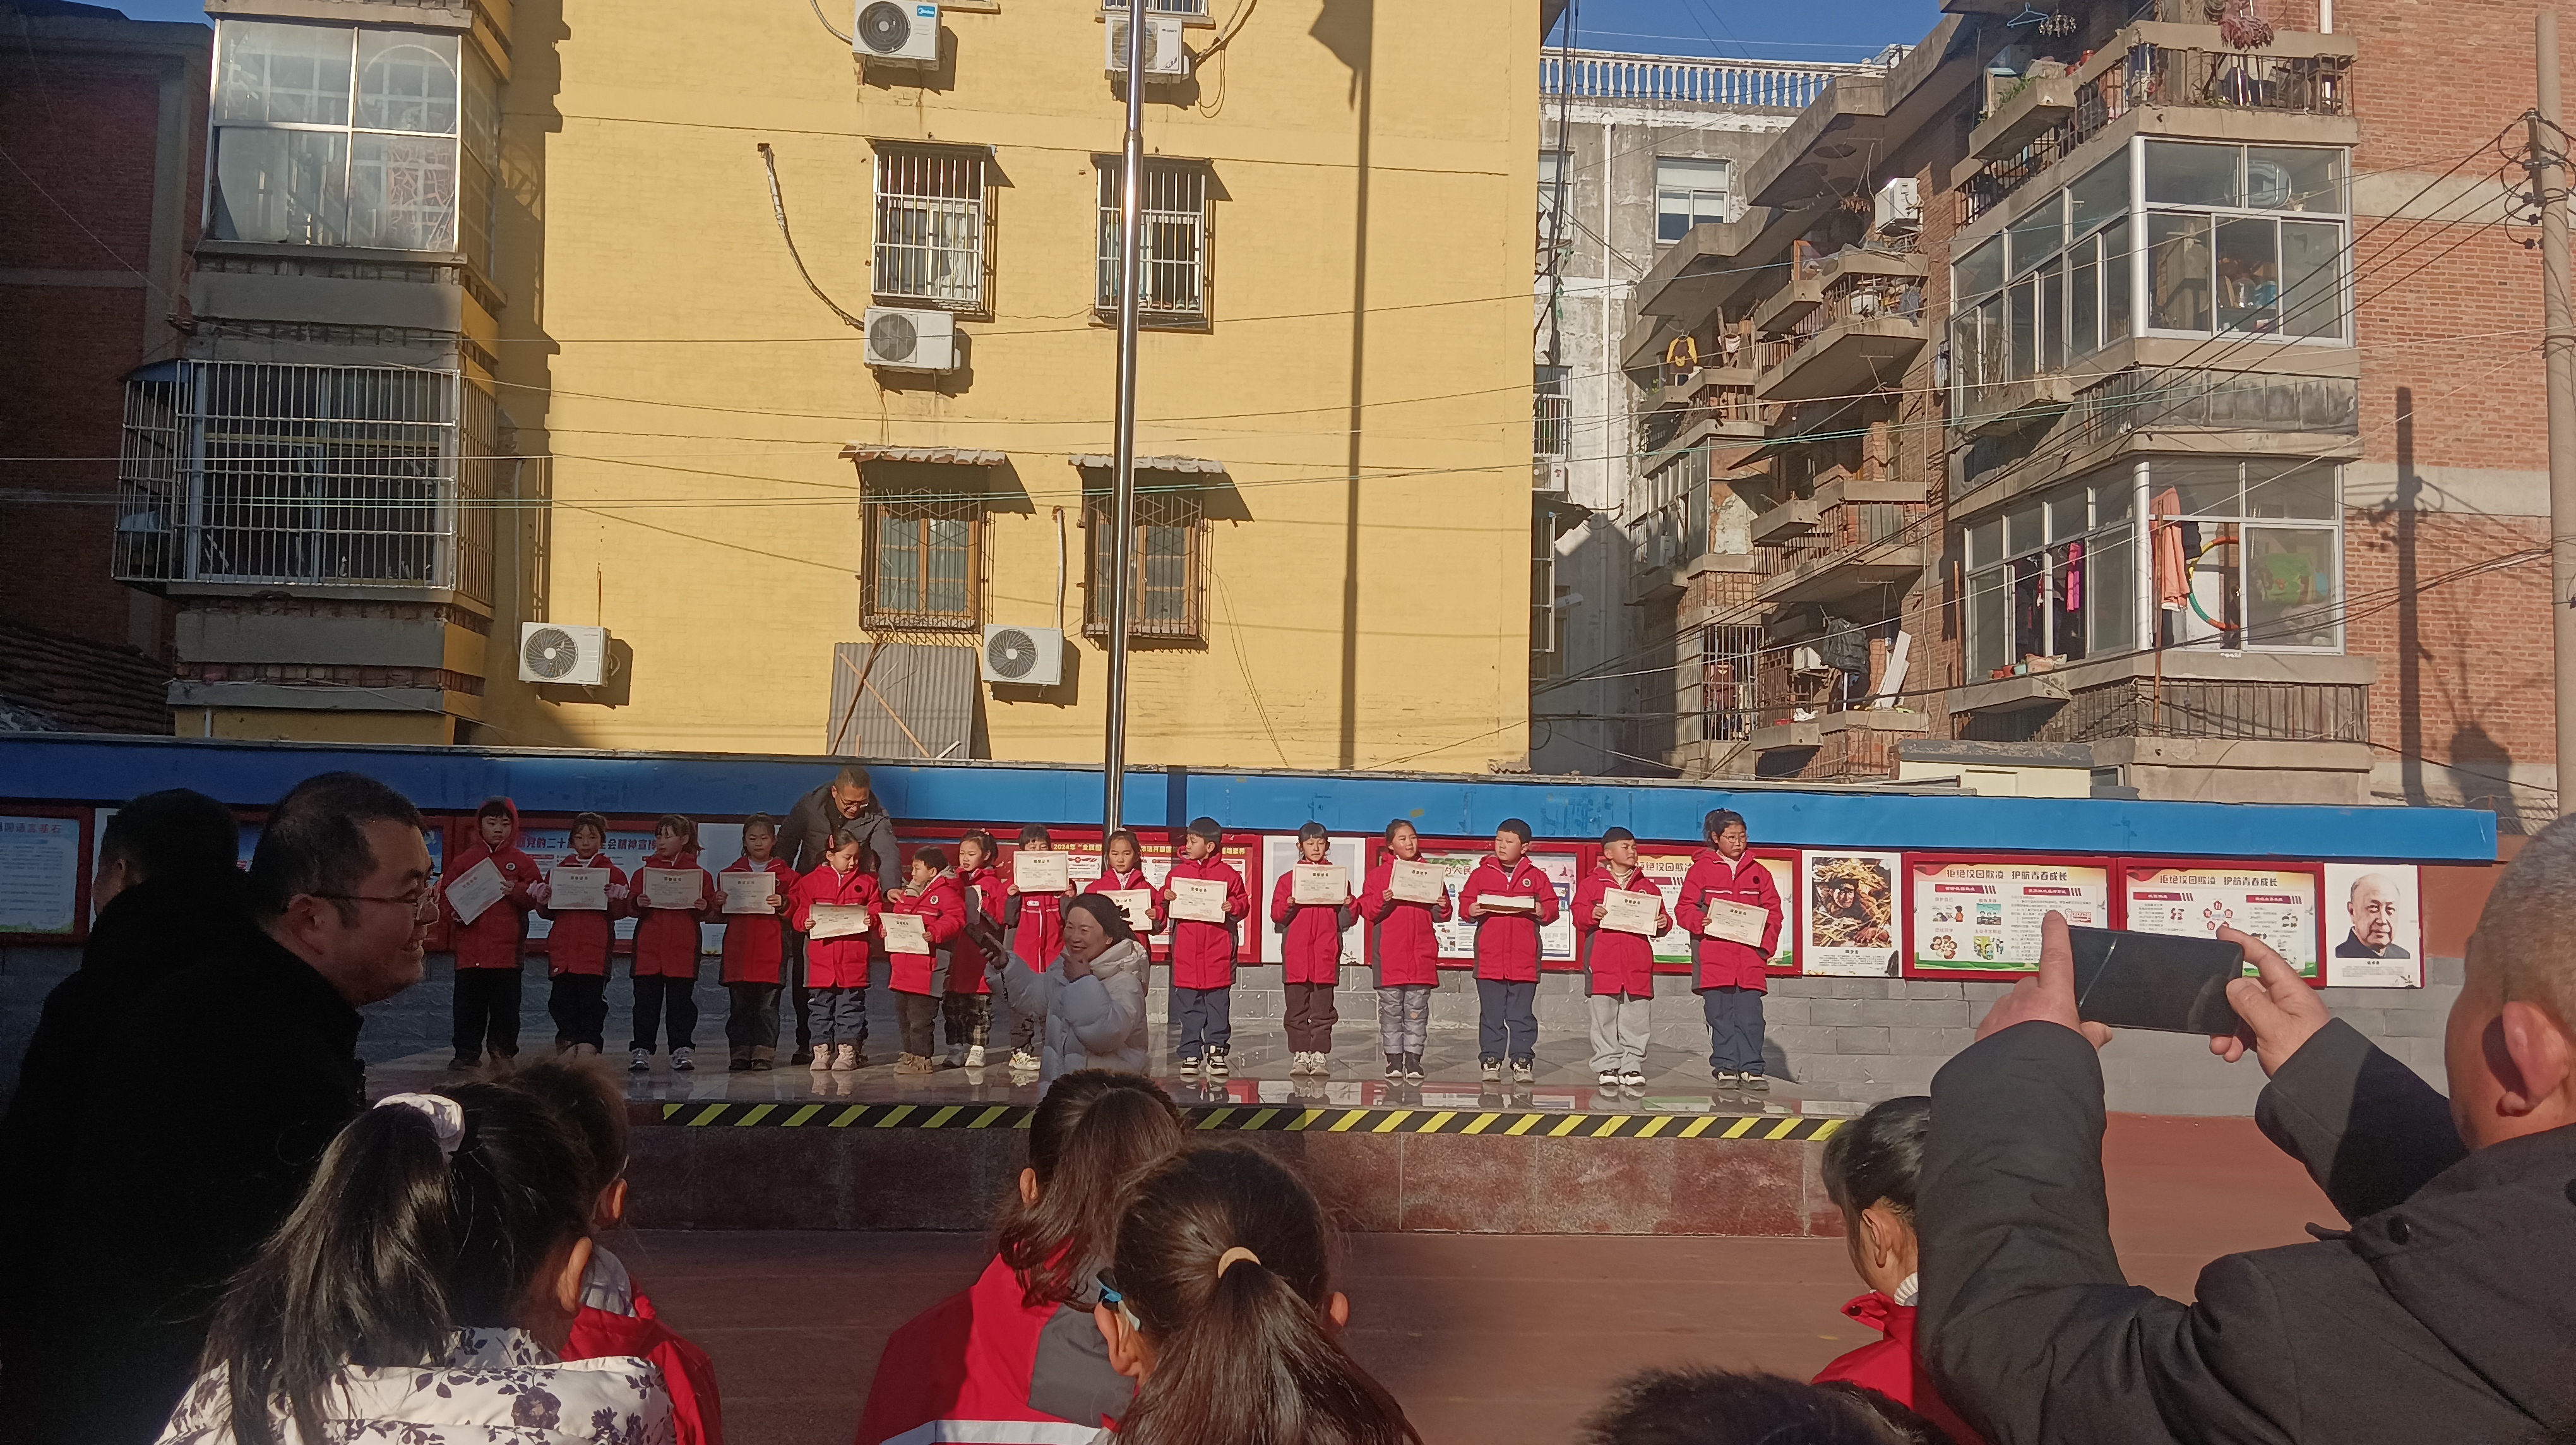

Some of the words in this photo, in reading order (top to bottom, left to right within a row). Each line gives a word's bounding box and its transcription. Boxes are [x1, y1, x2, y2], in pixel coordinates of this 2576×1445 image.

[0, 822, 61, 834] 国语言基石
[1947, 869, 2004, 879] 拒绝校园欺凌
[2012, 870, 2068, 881] 护航青春成长
[2160, 875, 2215, 885] 拒绝校园欺凌
[2224, 876, 2277, 887] 护航青春成长
